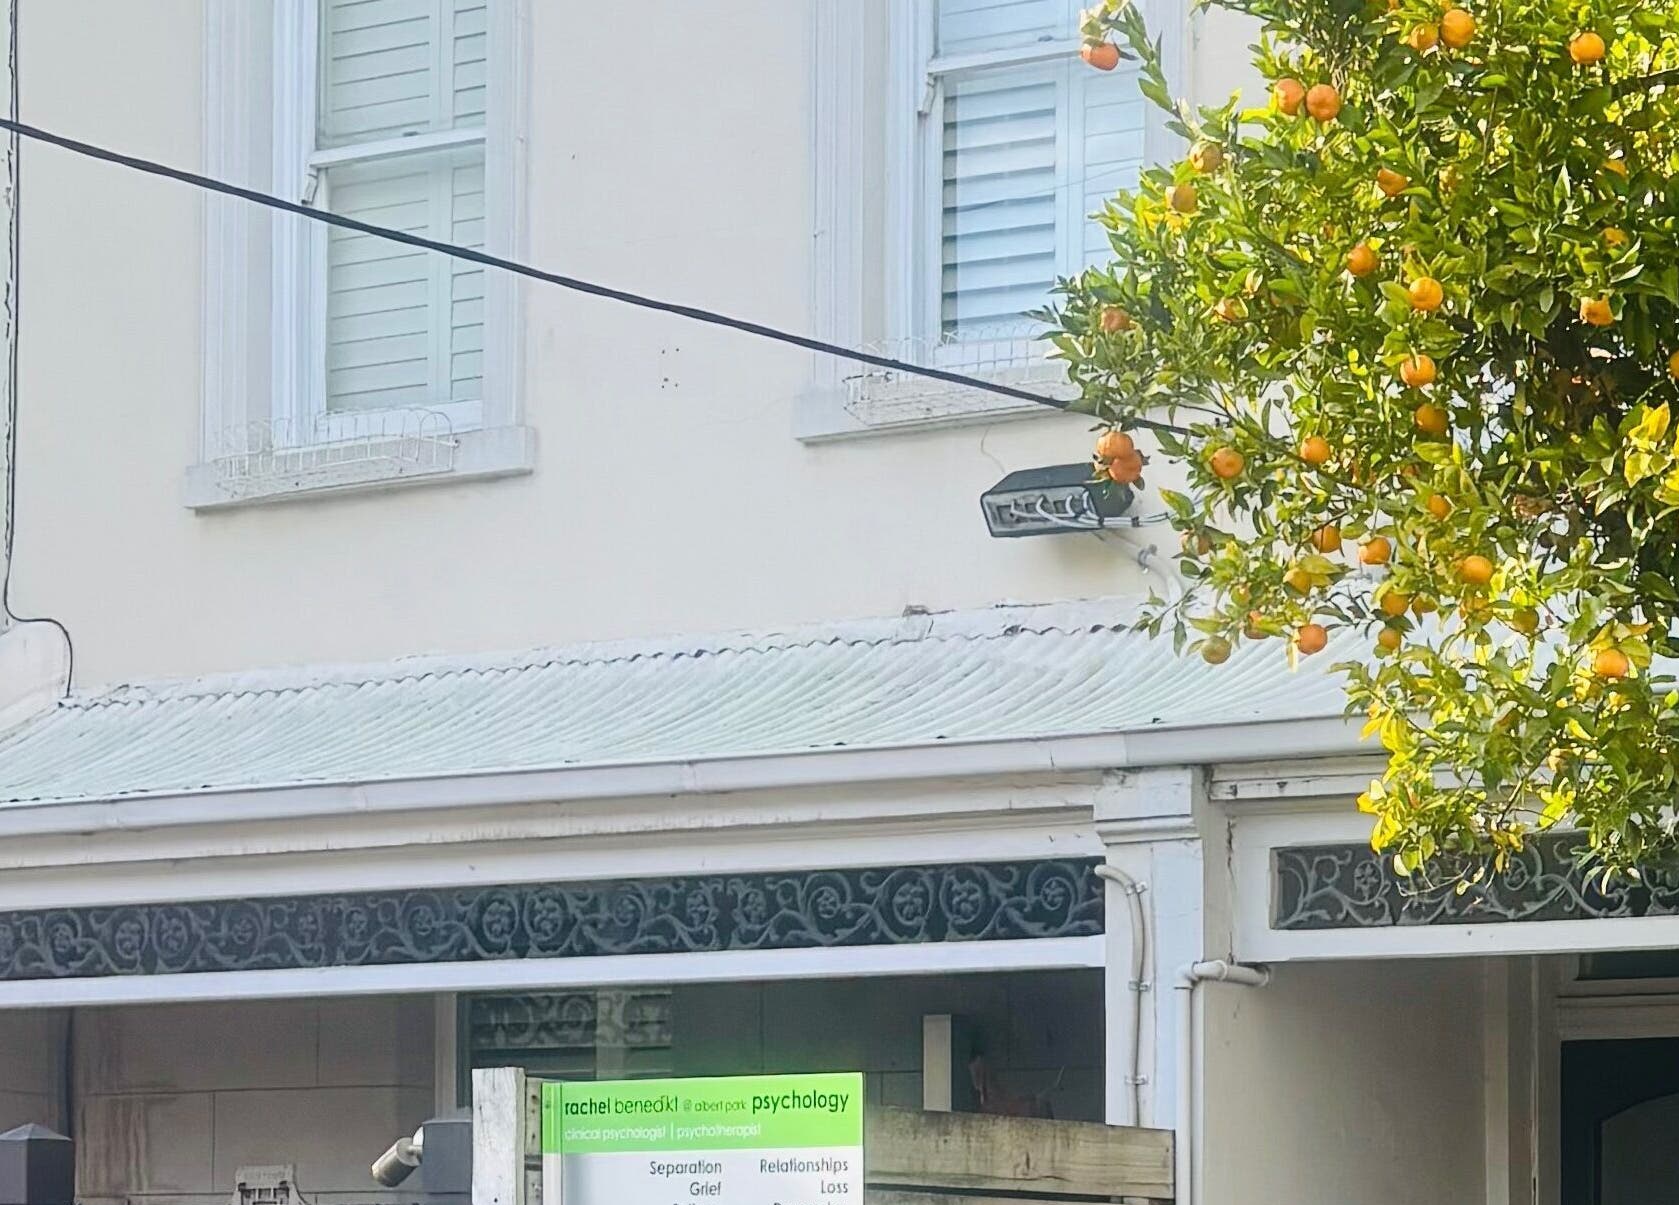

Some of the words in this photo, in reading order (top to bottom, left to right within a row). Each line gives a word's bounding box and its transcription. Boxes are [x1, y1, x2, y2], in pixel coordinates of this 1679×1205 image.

[565, 1097, 610, 1115] rachel
[752, 1089, 849, 1115] psychology
[602, 1124, 666, 1141] psychologist
[676, 1122, 761, 1139] psychotherapist
[649, 1160, 723, 1178] Separation
[760, 1157, 849, 1174] Relationships
[689, 1181, 723, 1196] Grief
[820, 1179, 849, 1194] Loss
